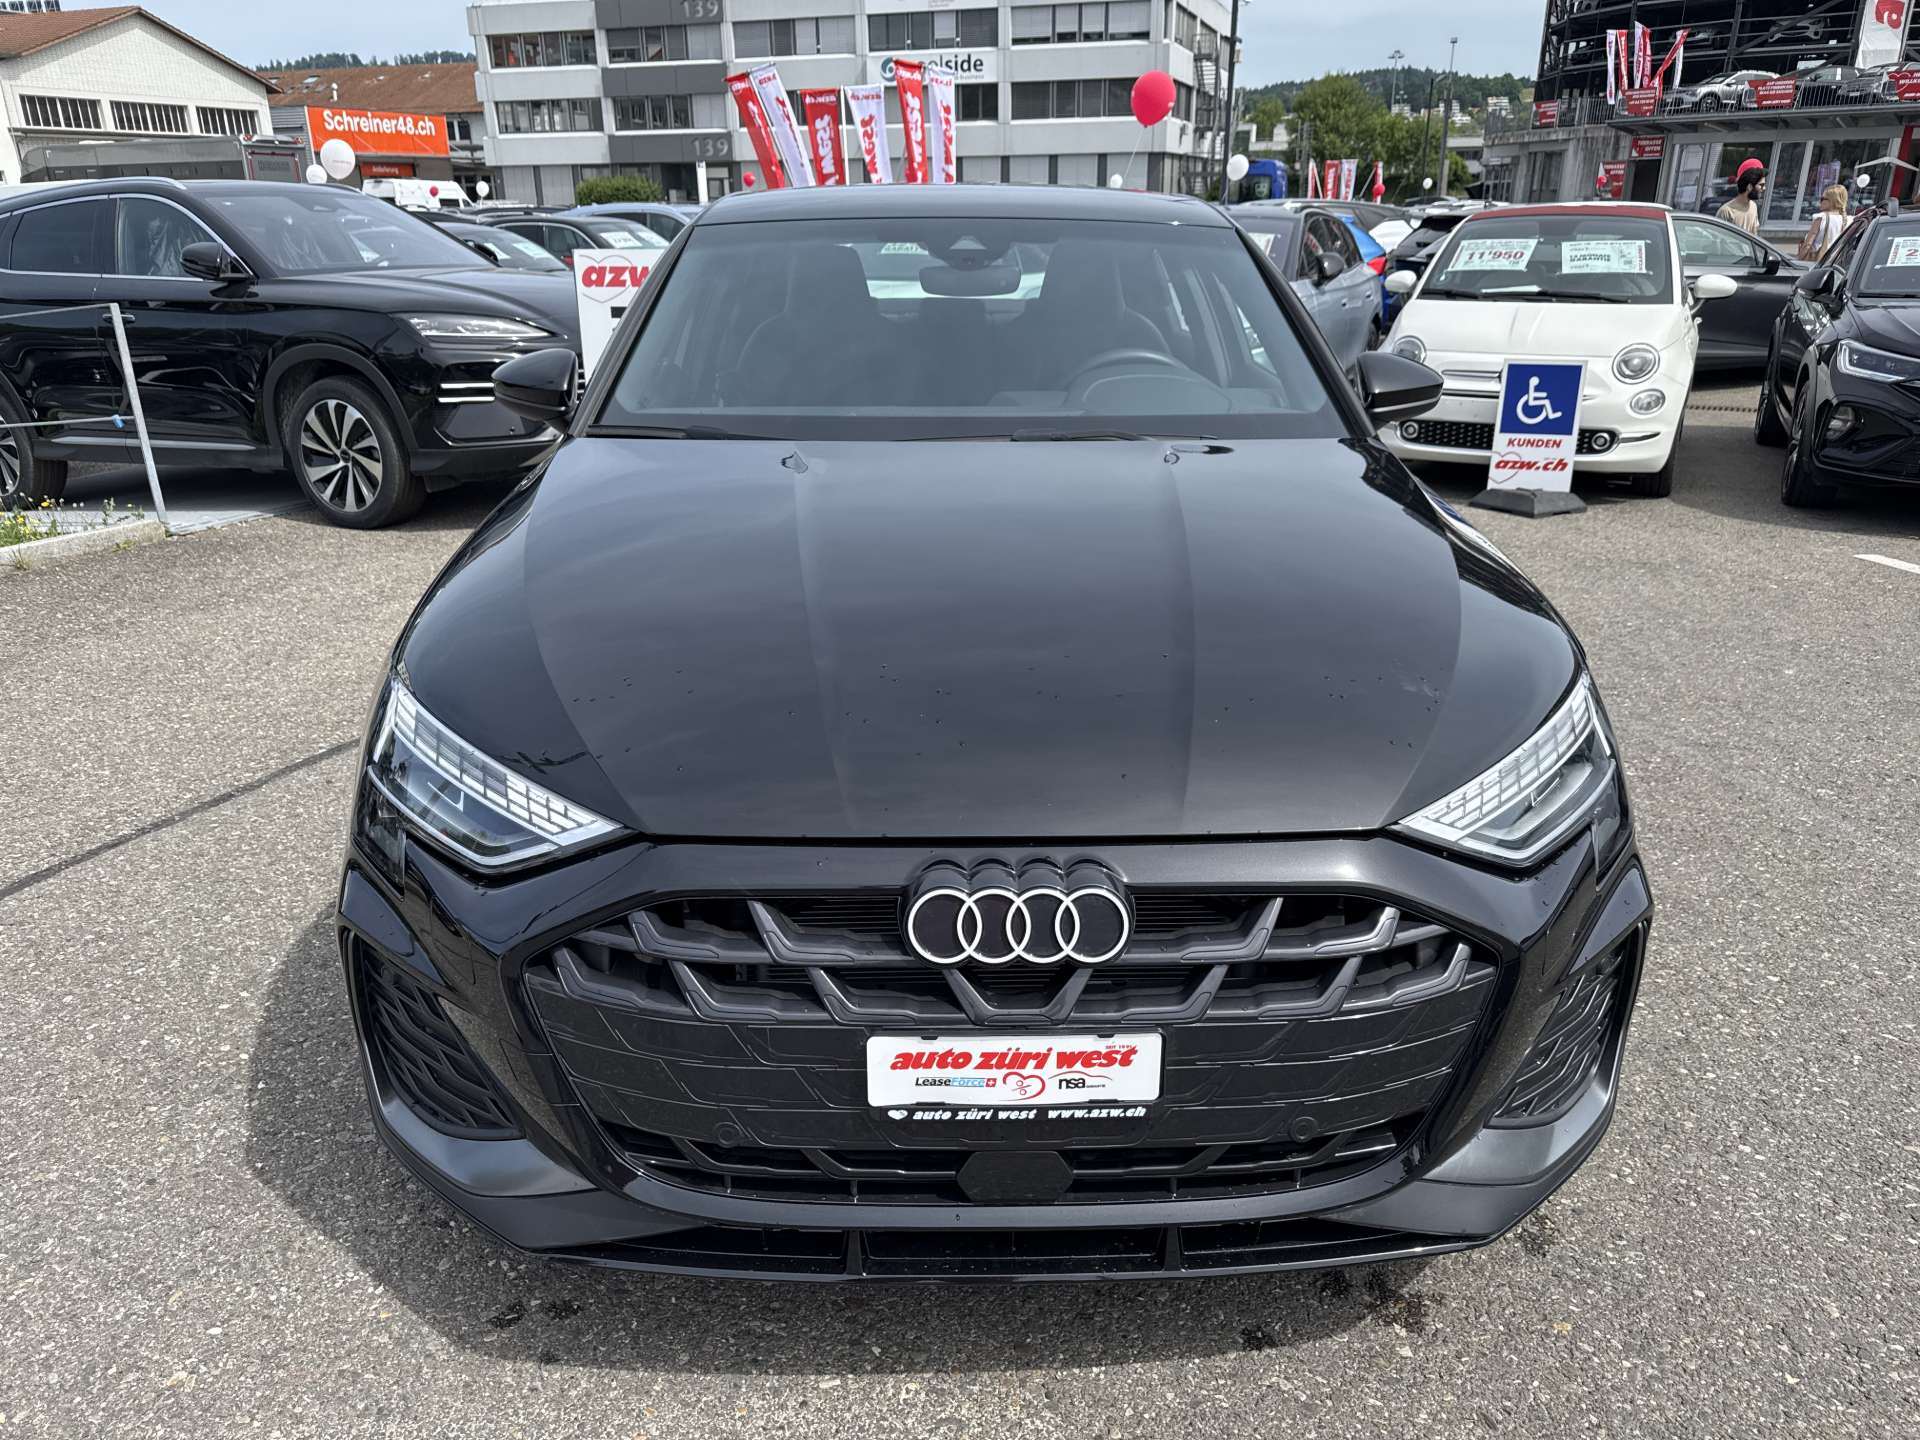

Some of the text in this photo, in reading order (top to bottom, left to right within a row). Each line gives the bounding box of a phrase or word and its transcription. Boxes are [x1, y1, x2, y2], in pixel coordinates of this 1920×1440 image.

[682, 0, 719, 18] 139
[322, 108, 436, 137] Schreiner48.ch
[693, 137, 729, 157] 139
[1468, 250, 1525, 261] 11'950
[1507, 437, 1563, 449] KUNDEN
[1494, 458, 1569, 472] azw.ch
[890, 1045, 1138, 1071] auto züri west
[914, 1076, 985, 1087] LeaseForce
[1058, 1078, 1086, 1090] nsa
[912, 1106, 1146, 1120] auto züri west www.azw.ch
